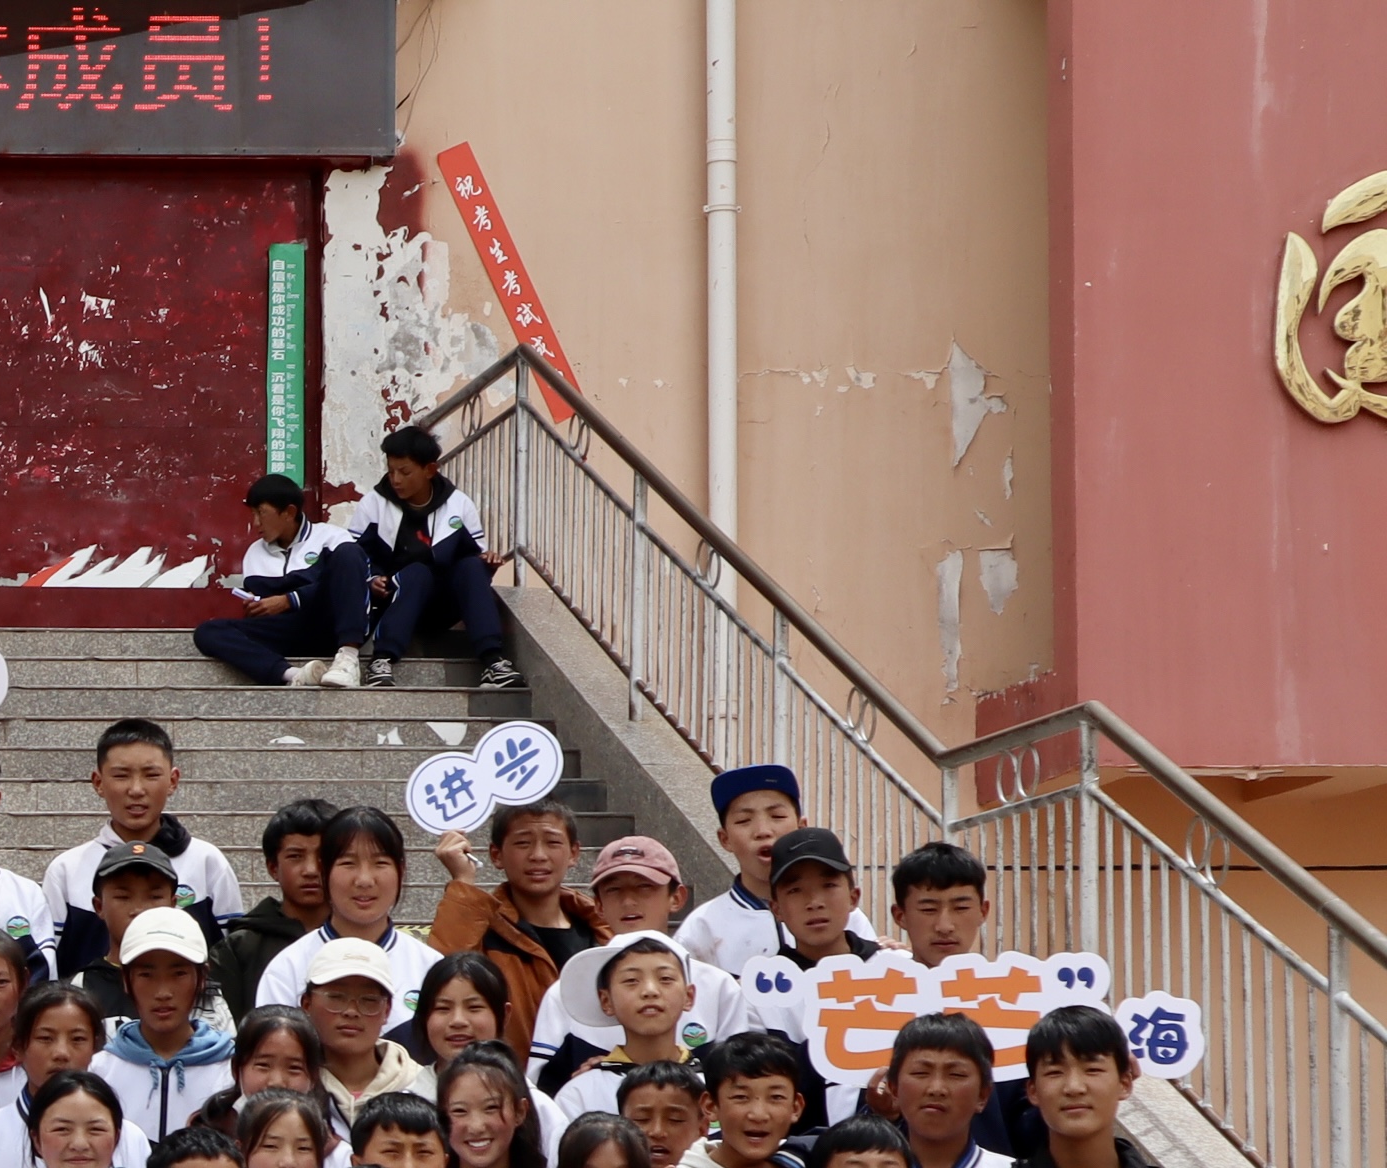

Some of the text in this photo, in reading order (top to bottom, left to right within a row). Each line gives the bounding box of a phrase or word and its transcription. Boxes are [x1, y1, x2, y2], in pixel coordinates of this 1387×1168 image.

[455, 175, 564, 389] 祝考生考试成
[270, 260, 286, 473] 自信是你成功的基石 沉着是你飞翔的翅膀
[424, 737, 541, 822] 进步
[1130, 1006, 1190, 1066] 海
